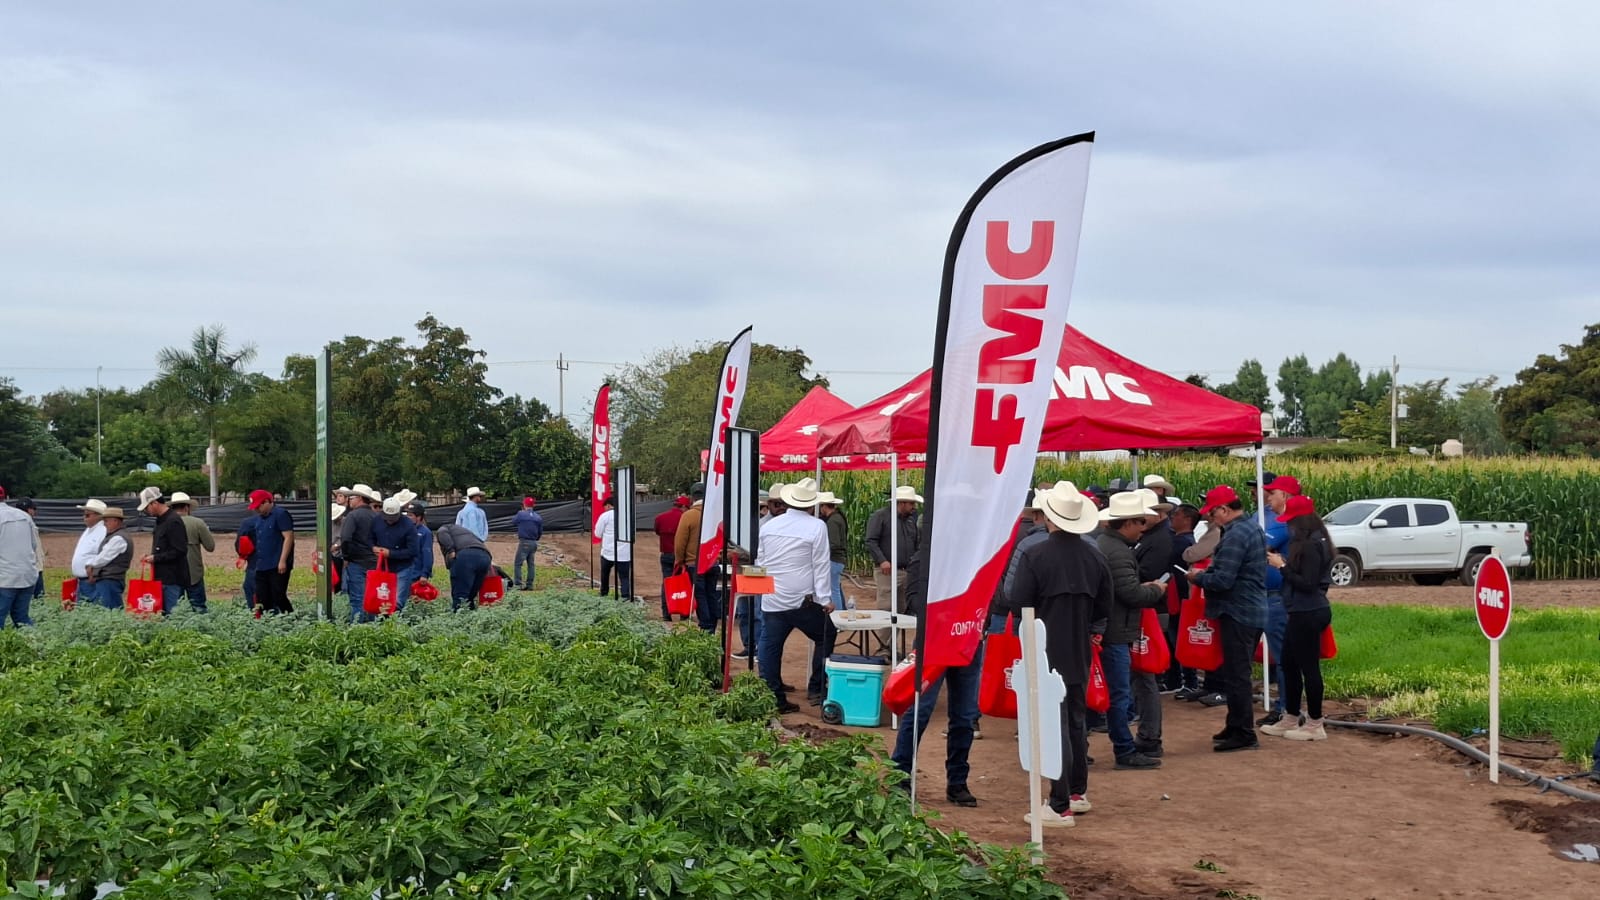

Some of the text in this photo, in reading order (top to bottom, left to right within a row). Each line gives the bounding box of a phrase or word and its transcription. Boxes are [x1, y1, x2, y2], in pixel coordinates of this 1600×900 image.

[970, 220, 1055, 475] FMC
[1048, 365, 1153, 406] MC
[594, 423, 608, 500] FMC
[780, 454, 808, 464] FMC
[906, 453, 927, 462] FM
[1479, 587, 1504, 609] FMC
